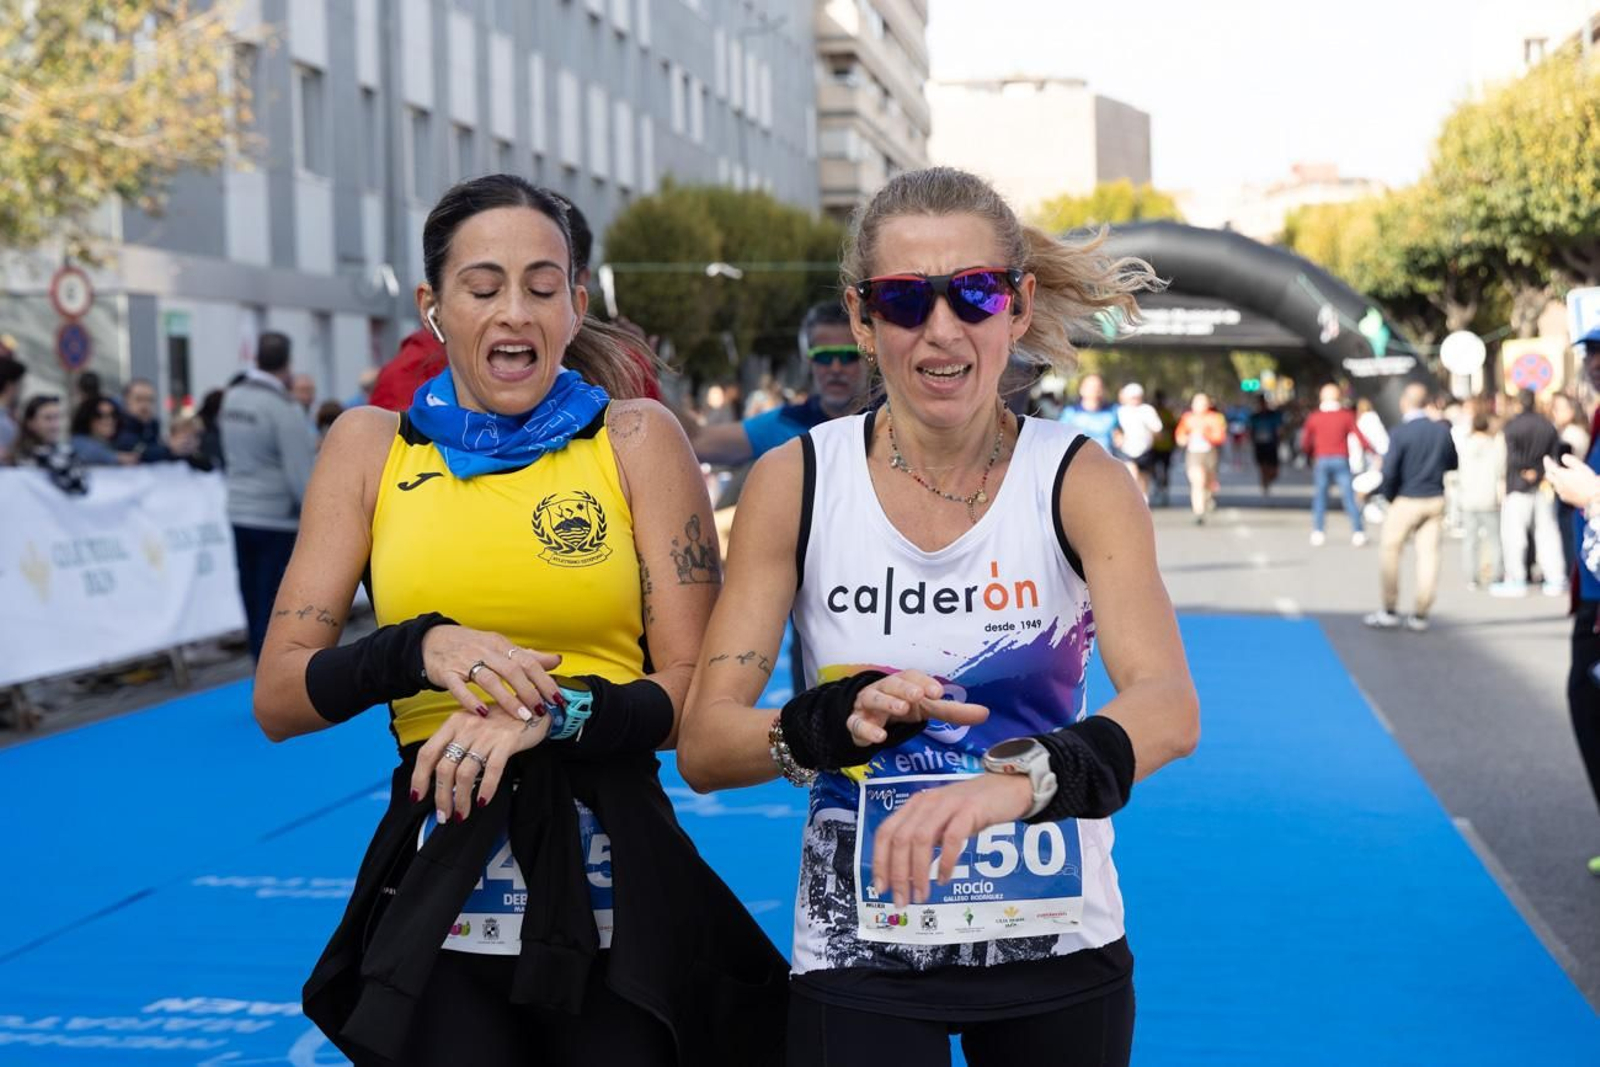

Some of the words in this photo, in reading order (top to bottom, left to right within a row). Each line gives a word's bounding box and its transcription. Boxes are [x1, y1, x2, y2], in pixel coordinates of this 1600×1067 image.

[827, 561, 1039, 635] calderón
[984, 622, 1016, 633] desde
[1020, 619, 1042, 631] 1949
[953, 880, 994, 895] ROCÍO
